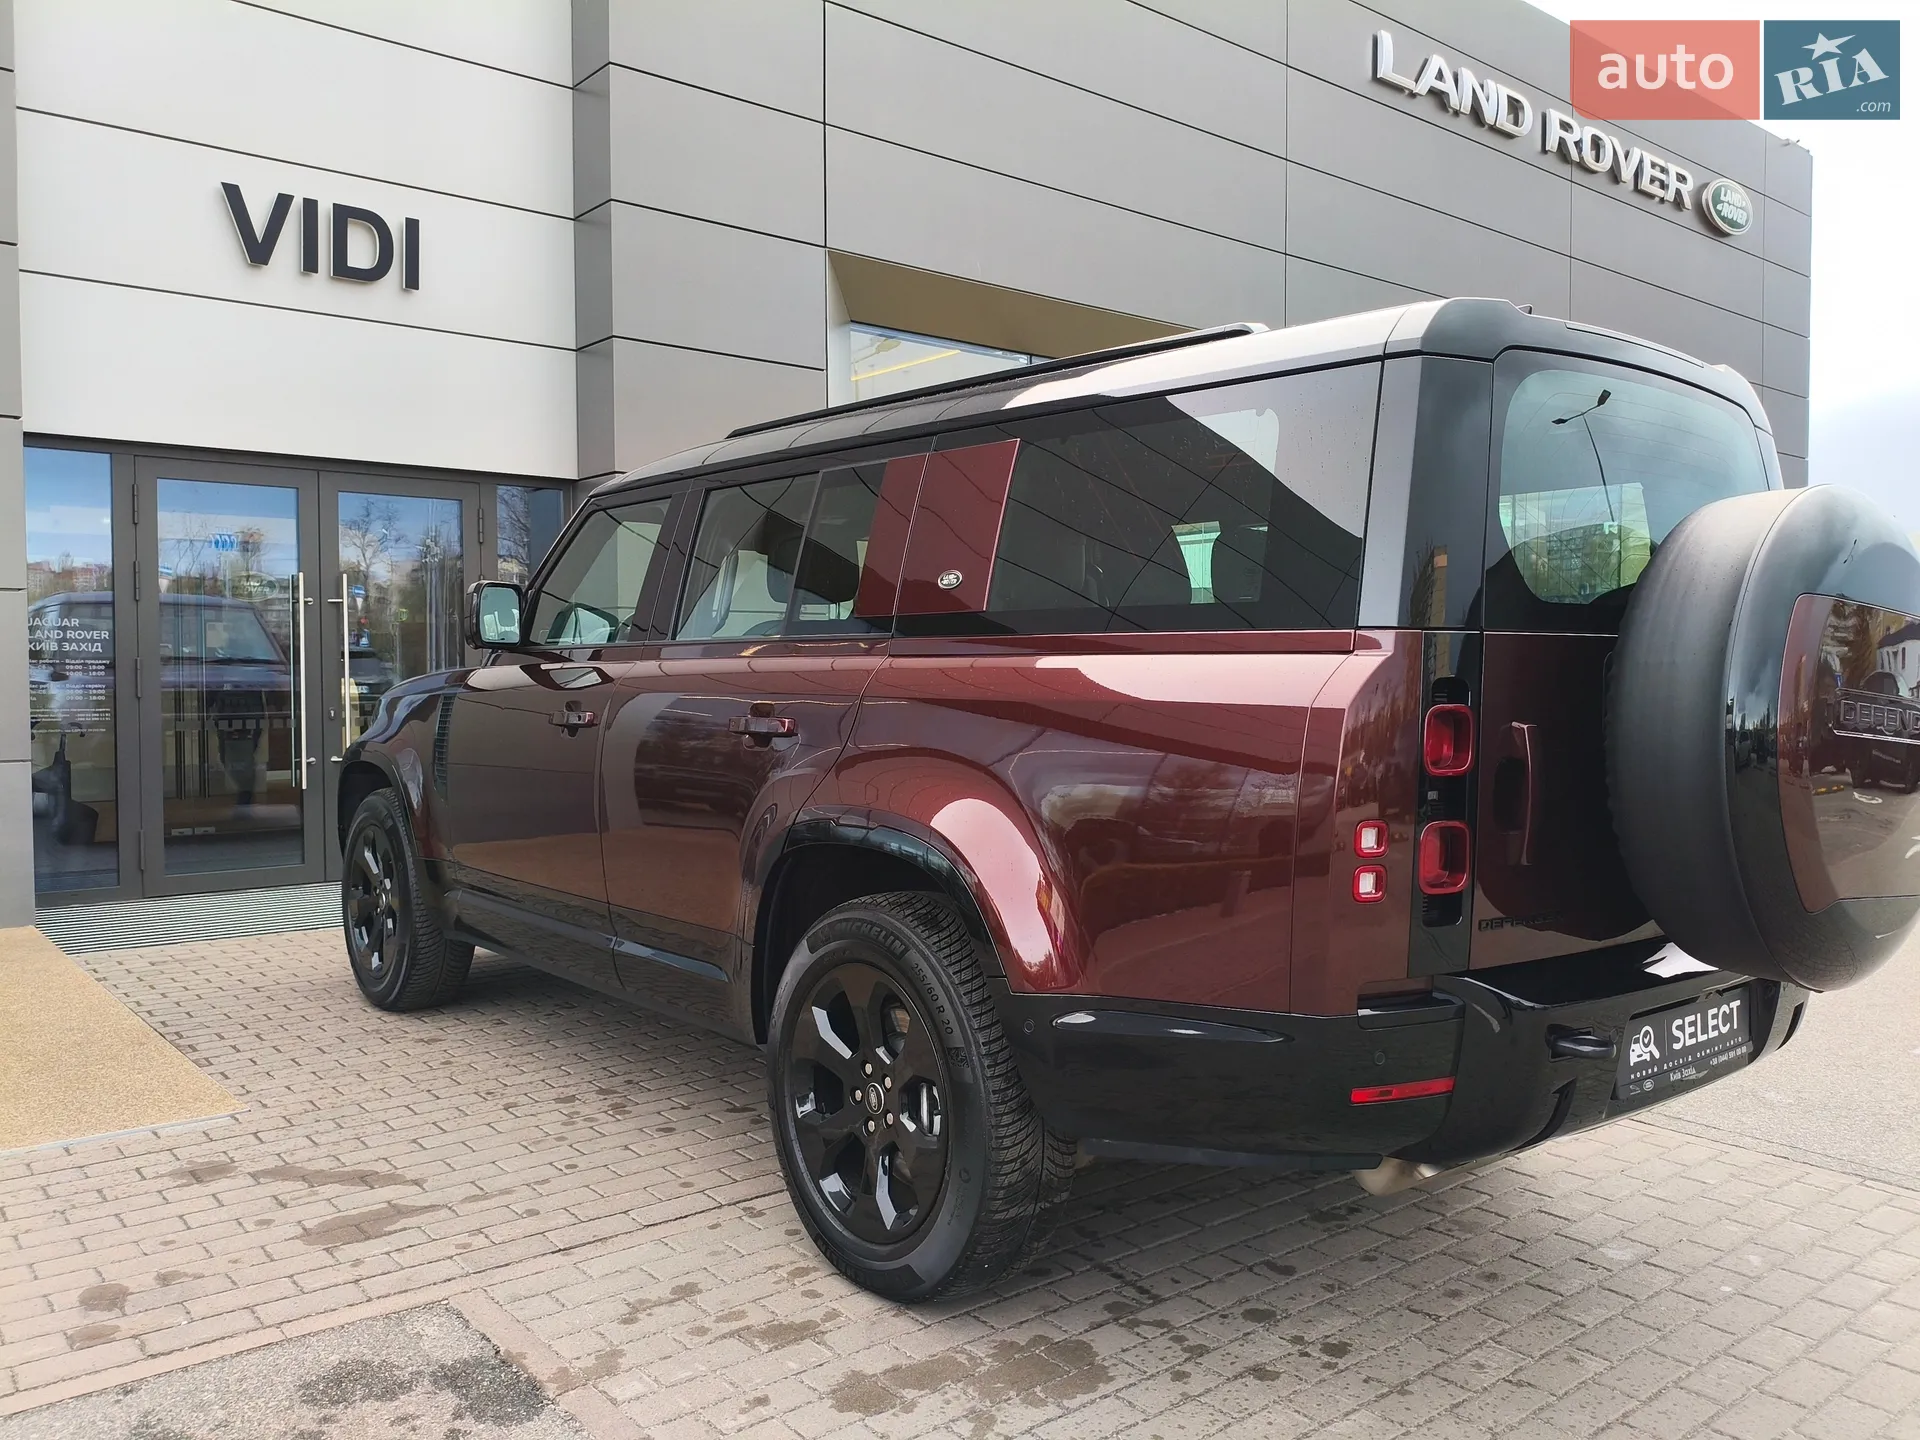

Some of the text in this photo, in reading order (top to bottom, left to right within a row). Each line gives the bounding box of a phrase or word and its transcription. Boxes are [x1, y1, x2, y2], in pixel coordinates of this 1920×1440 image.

[1372, 30, 1694, 211] LAND ROVER
[1719, 186, 1742, 208] LAND
[1720, 202, 1748, 226] ROVER
[220, 181, 420, 291] VIDI
[62, 643, 103, 653] ЗАХІД
[66, 631, 110, 640] ROVER
[832, 920, 906, 955] MICHELIN
[911, 962, 954, 1035] 255/60 R 20
[1671, 1000, 1741, 1050] SELECT
